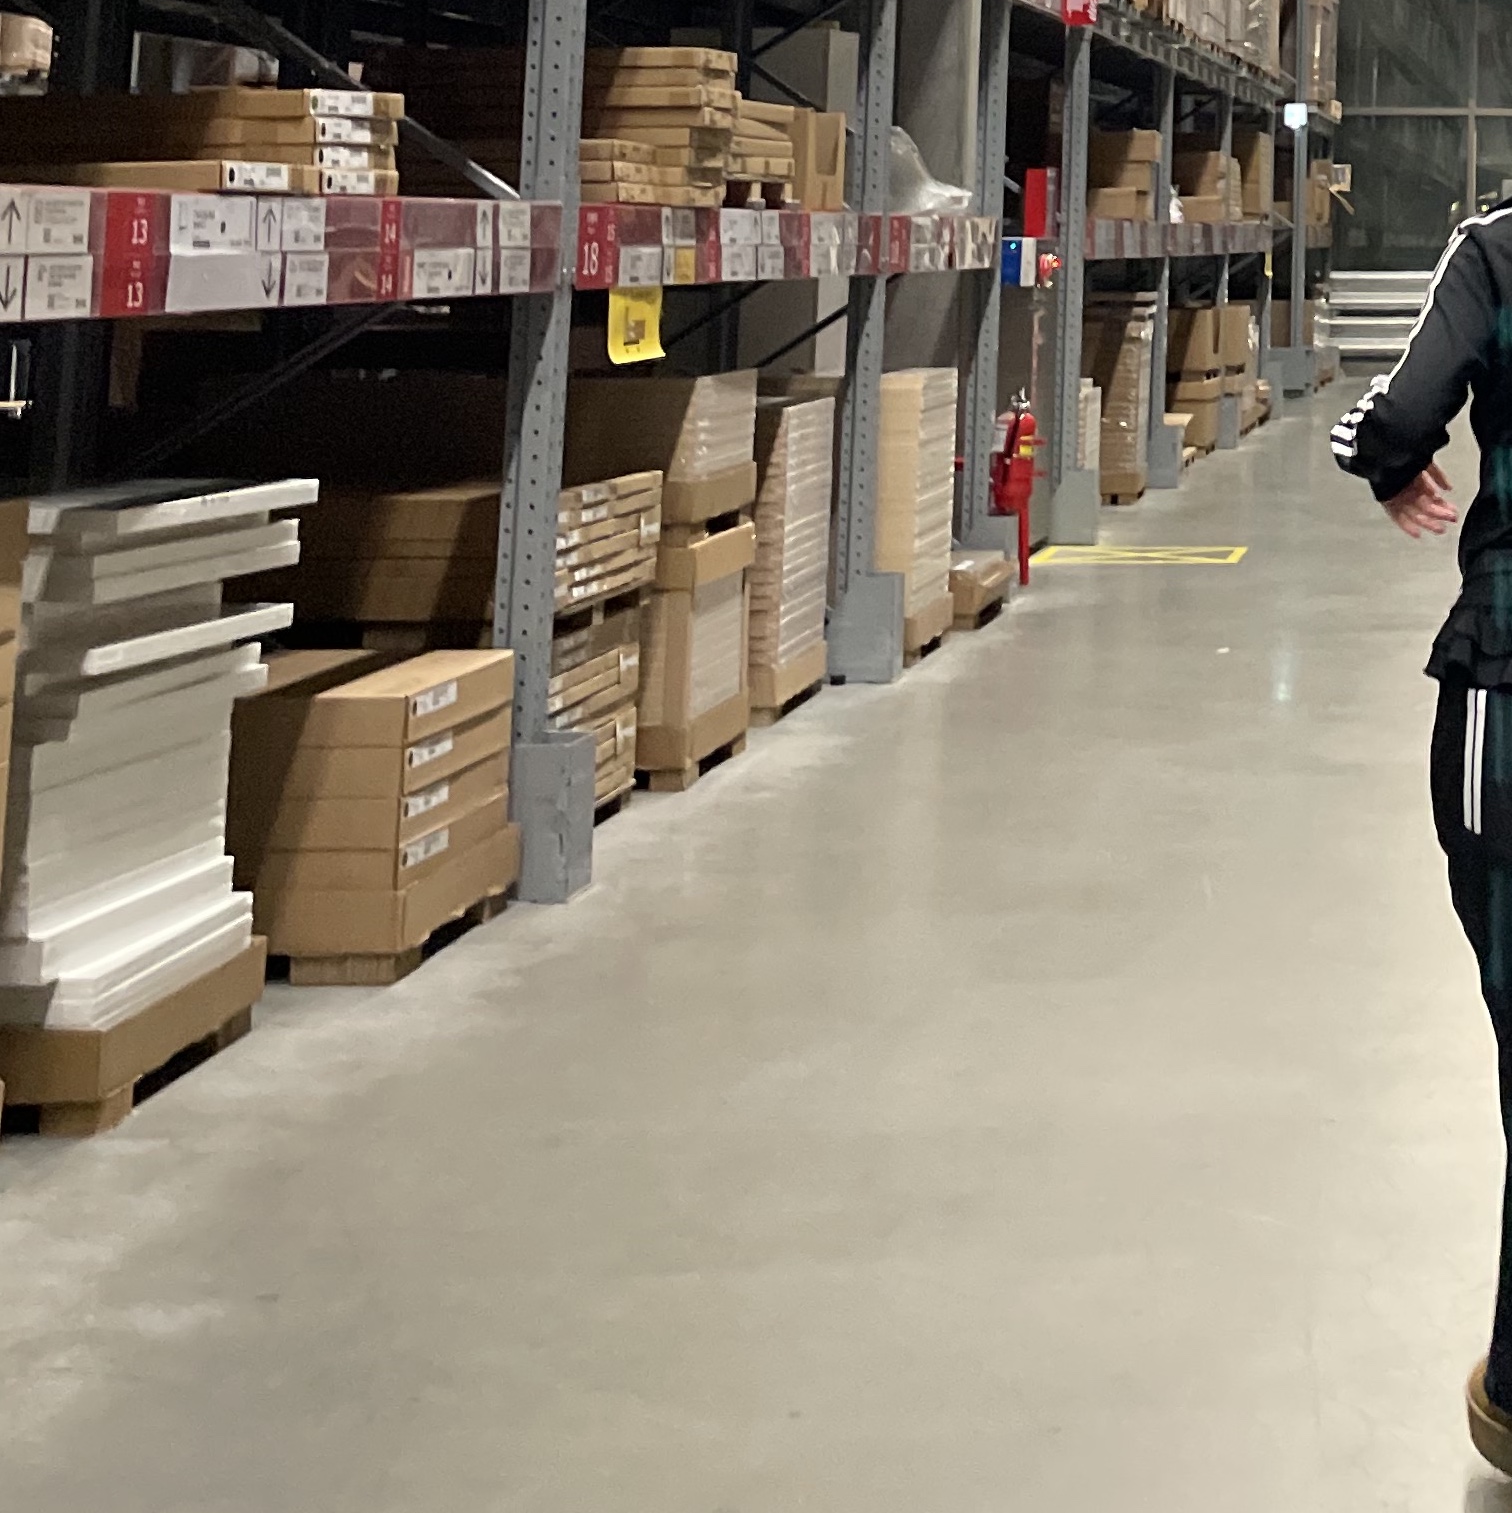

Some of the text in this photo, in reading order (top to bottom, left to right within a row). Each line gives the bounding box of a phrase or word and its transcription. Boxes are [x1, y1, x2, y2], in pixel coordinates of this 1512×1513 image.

[131, 218, 148, 245] 13
[384, 222, 396, 243] 14
[582, 241, 599, 276] 18
[126, 281, 144, 308] 13
[381, 273, 393, 295] 14
